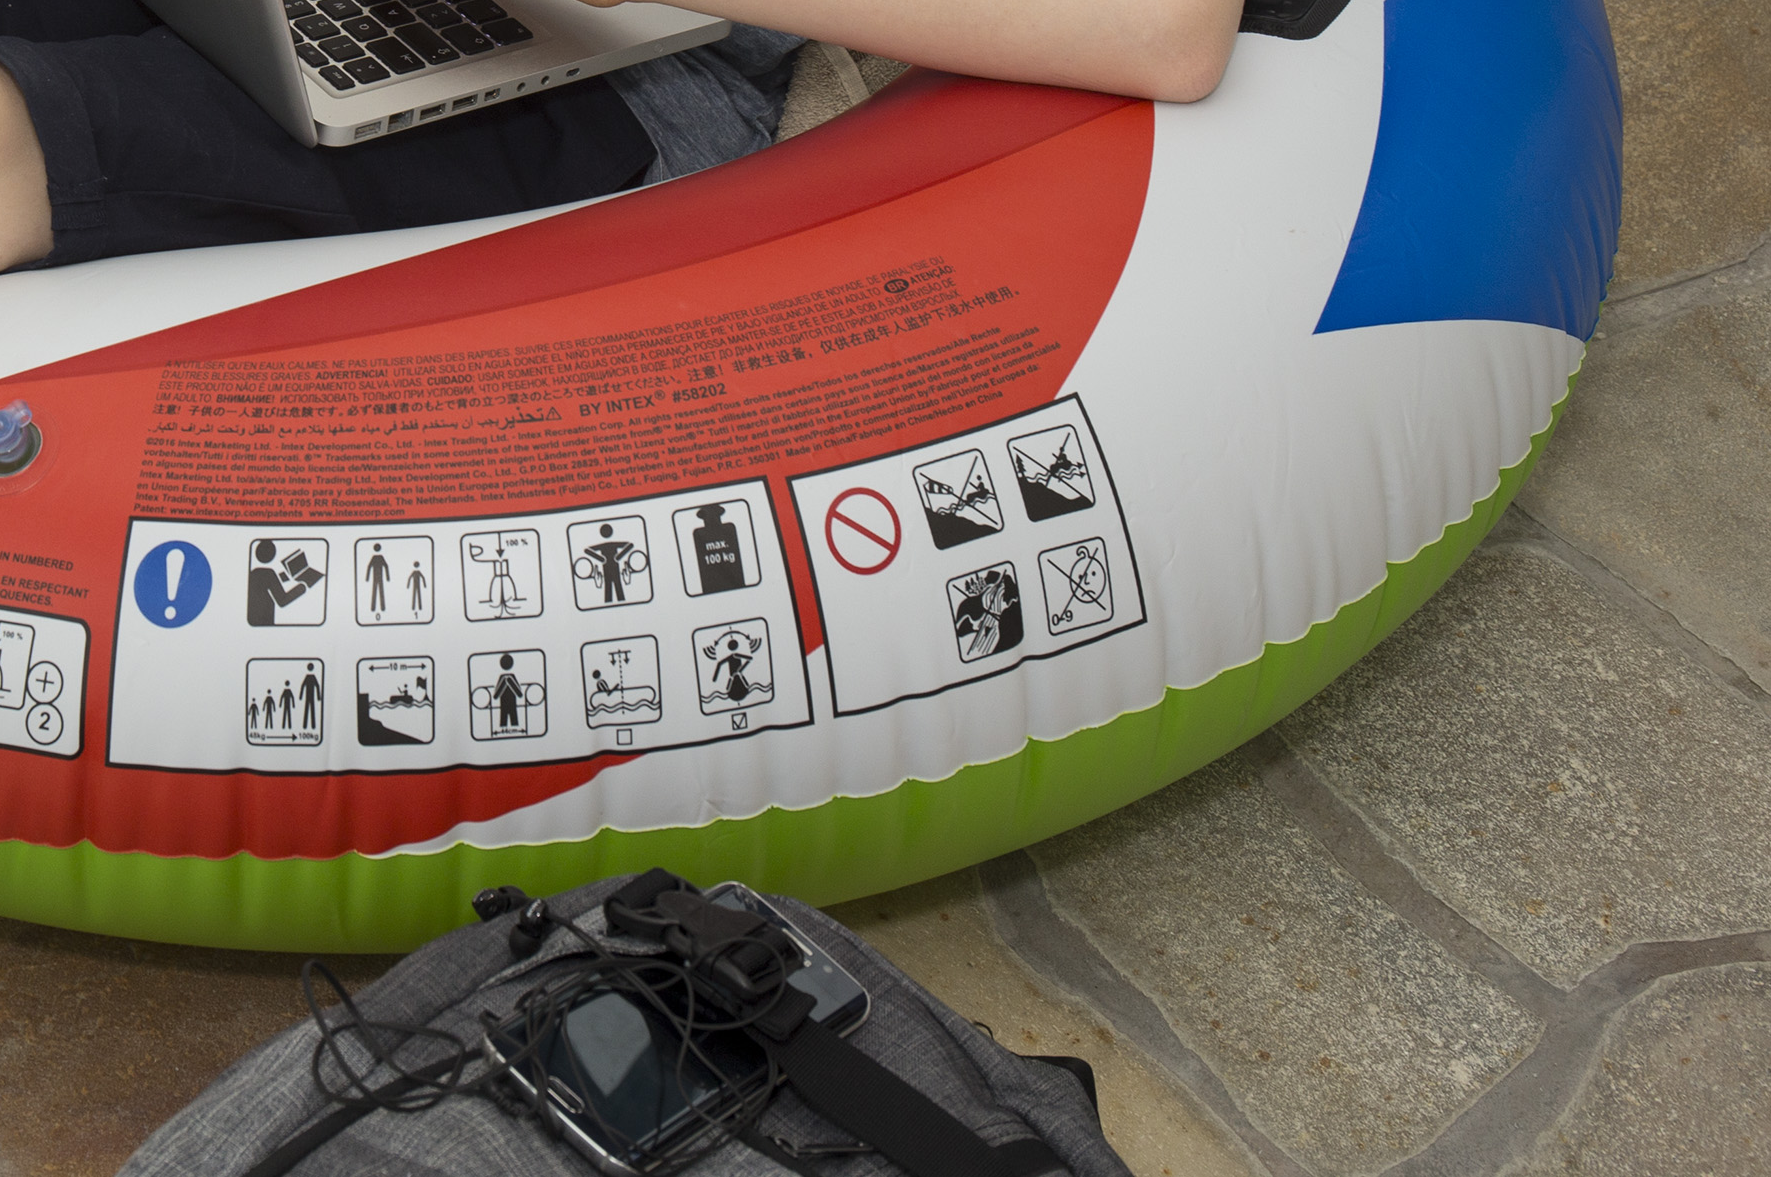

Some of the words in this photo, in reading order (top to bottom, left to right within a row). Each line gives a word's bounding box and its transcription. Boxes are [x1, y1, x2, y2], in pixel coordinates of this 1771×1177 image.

[315, 369, 388, 380] ADVERTENCIA!
[910, 265, 956, 284] ATENÇÃO:
[427, 375, 474, 387] CUIDADO:
[146, 437, 175, 447] ©2016
[178, 439, 201, 448] Intex
[204, 440, 251, 452] Marketing
[253, 442, 272, 451] Ltd.
[281, 442, 304, 451] Intex
[307, 442, 372, 452] Development
[374, 441, 394, 450] Co.,
[396, 440, 415, 449] Ltd.
[423, 439, 448, 447] Intex
[451, 436, 488, 446] Trading
[490, 433, 509, 443] Ltd.
[517, 431, 542, 440] Intex
[544, 425, 597, 437] Recreation
[599, 421, 625, 431] Corp.
[628, 417, 642, 427] All
[643, 414, 672, 425] rights
[674, 401, 741, 419] reserved/Tous
[743, 395, 771, 406] droits
[772, 377, 843, 399] réservés/Todos
[843, 373, 859, 382] los
[860, 360, 902, 377] derechos
[903, 338, 970, 365] reservados/Alle
[970, 327, 1001, 342] Rechte
[216, 394, 275, 404] ВНИМАНИЕ!
[579, 402, 601, 417] BY
[672, 382, 727, 403] #58202
[136, 492, 159, 502] Intex
[163, 493, 198, 506] Trading
[200, 495, 221, 506] B.V.,
[224, 497, 275, 507] Venneveld
[277, 498, 285, 508] 9,
[288, 498, 312, 507] 4705
[314, 498, 329, 507] RR
[331, 497, 392, 507] Roosendaal,
[395, 497, 413, 506] The
[416, 494, 478, 505] Netherlands.
[480, 492, 505, 501] Intex
[507, 488, 556, 499] Industries
[558, 482, 596, 497] (Fujian)
[597, 480, 618, 490] Co.,
[619, 476, 642, 487] Ltd.,
[643, 472, 680, 483] Fuqing,
[682, 466, 716, 478] Fujian,
[717, 458, 746, 471] P.R.C.
[748, 451, 781, 465] 350301
[785, 445, 811, 457] Made
[813, 443, 823, 451] in
[823, 424, 893, 449] China/Fabriqué
[894, 421, 907, 430] en
[907, 404, 964, 426] Chine/Hecho
[965, 400, 977, 409] en
[977, 391, 1003, 404] China
[133, 503, 166, 513] Patent:
[170, 508, 303, 519] www.intexcorp.com/patents
[309, 509, 405, 518] www.intexcorp.com
[506, 539, 519, 547] 100
[706, 540, 729, 551] max.
[0, 551, 10, 561] IN
[12, 553, 74, 571] NUMBERED
[705, 553, 721, 565] 100
[722, 552, 736, 563] kg
[1, 575, 16, 587] EN
[18, 578, 90, 599] RESPECTANT
[376, 613, 381, 621] 0
[414, 611, 418, 619] 1
[1052, 609, 1073, 626] 0-9
[2, 631, 15, 639] 100
[390, 663, 398, 671] 10
[39, 712, 51, 731] 2
[298, 732, 319, 741] 100kg
